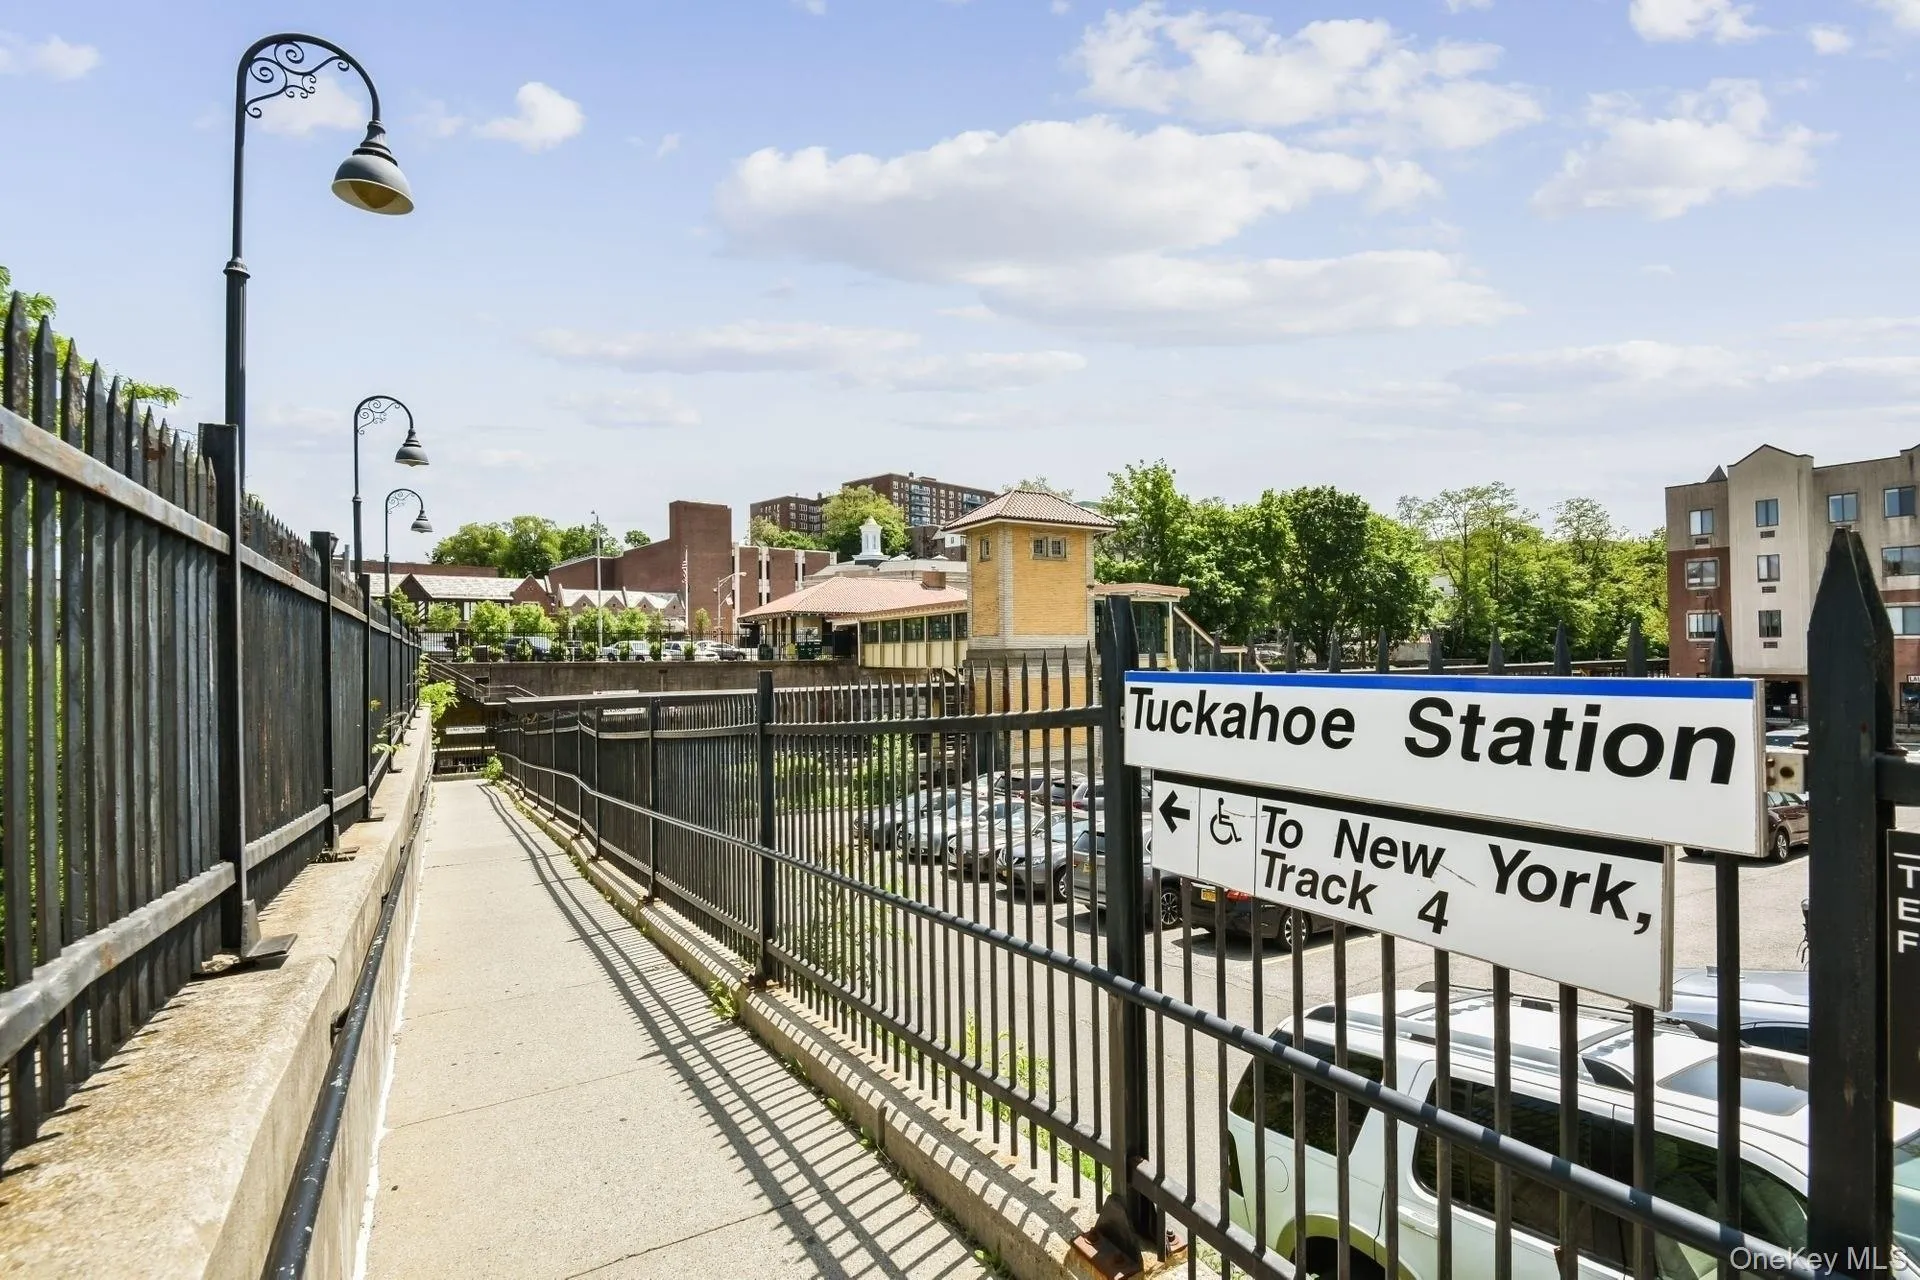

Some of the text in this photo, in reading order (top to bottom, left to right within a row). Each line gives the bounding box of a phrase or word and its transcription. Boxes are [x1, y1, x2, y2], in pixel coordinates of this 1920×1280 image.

[1129, 686, 1737, 785] Tuckahoe Station
[1260, 848, 1449, 935] Track 4
[1261, 805, 1652, 936] To New York,
